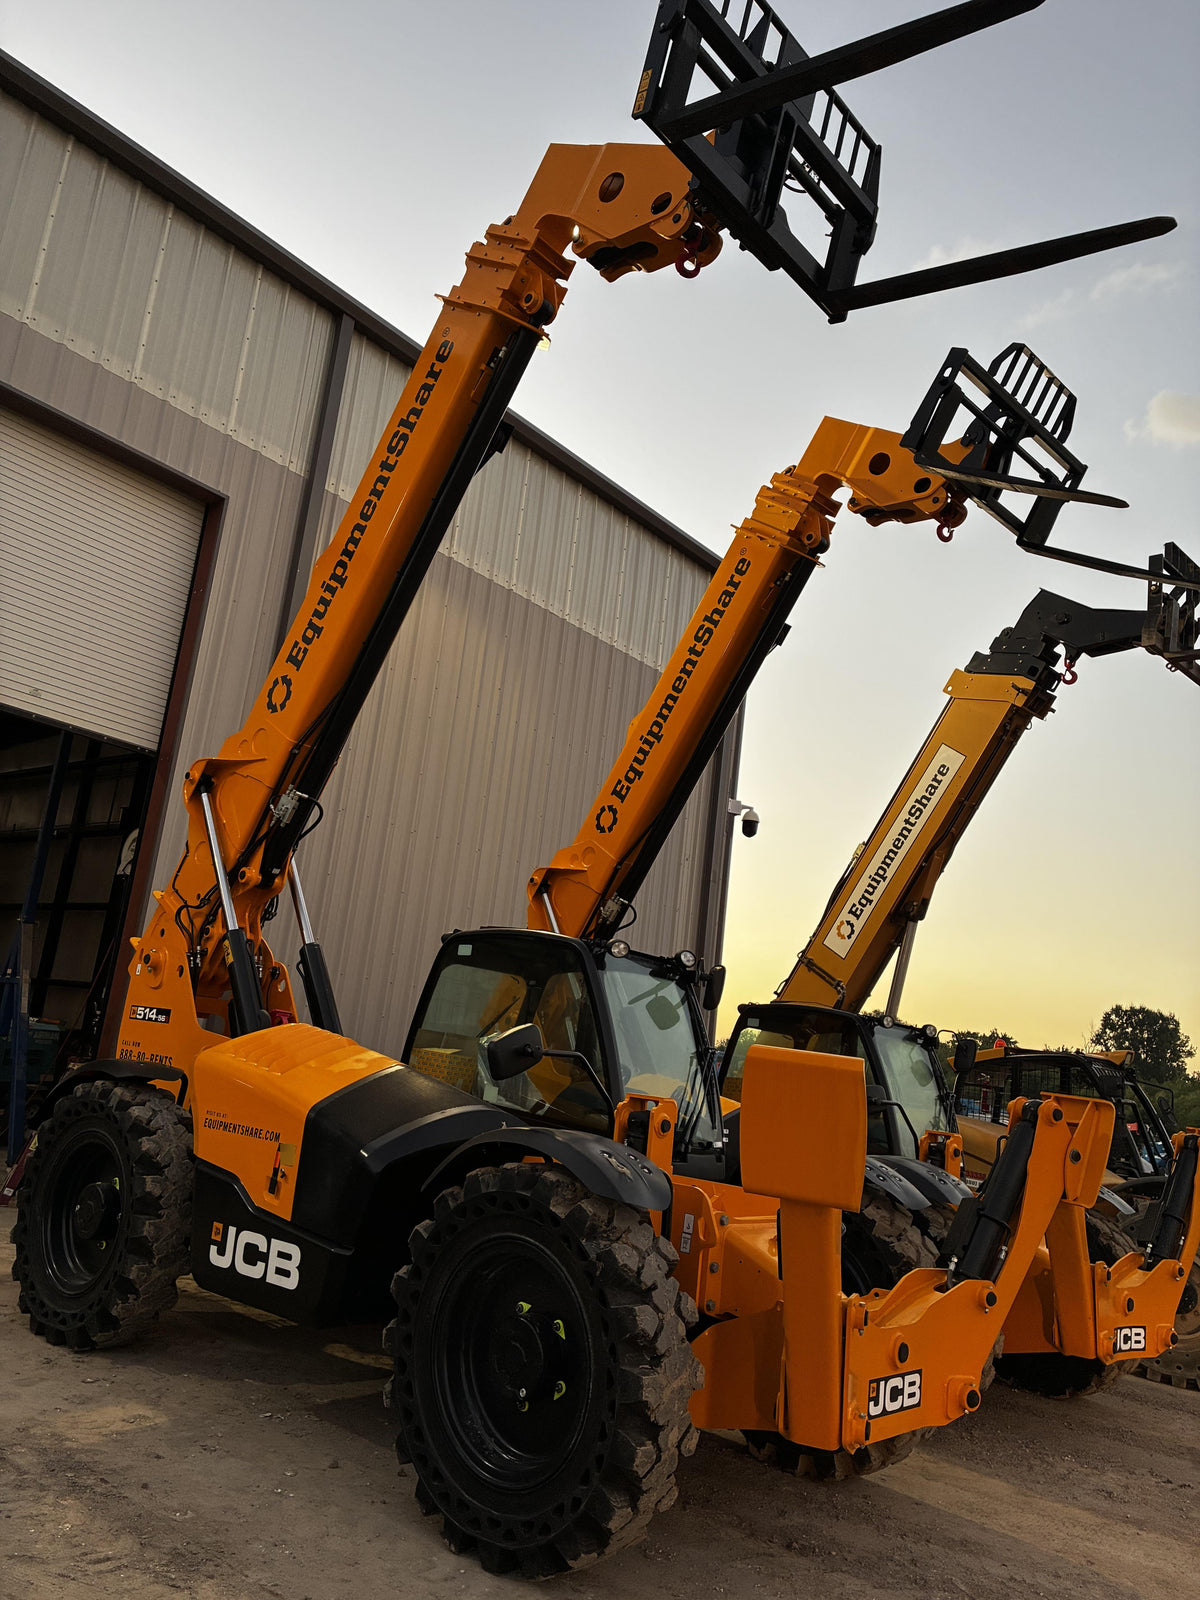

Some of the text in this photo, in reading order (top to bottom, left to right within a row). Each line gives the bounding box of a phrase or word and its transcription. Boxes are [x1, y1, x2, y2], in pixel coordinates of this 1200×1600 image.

[286, 339, 454, 671] EquipmentShare
[610, 556, 751, 804] EquipmentShare
[847, 763, 950, 921] EquipmentShare
[203, 1117, 281, 1143] EQUIPMENTSHARE.COM
[209, 1225, 301, 1290] JCB
[868, 1373, 921, 1416] JCB
